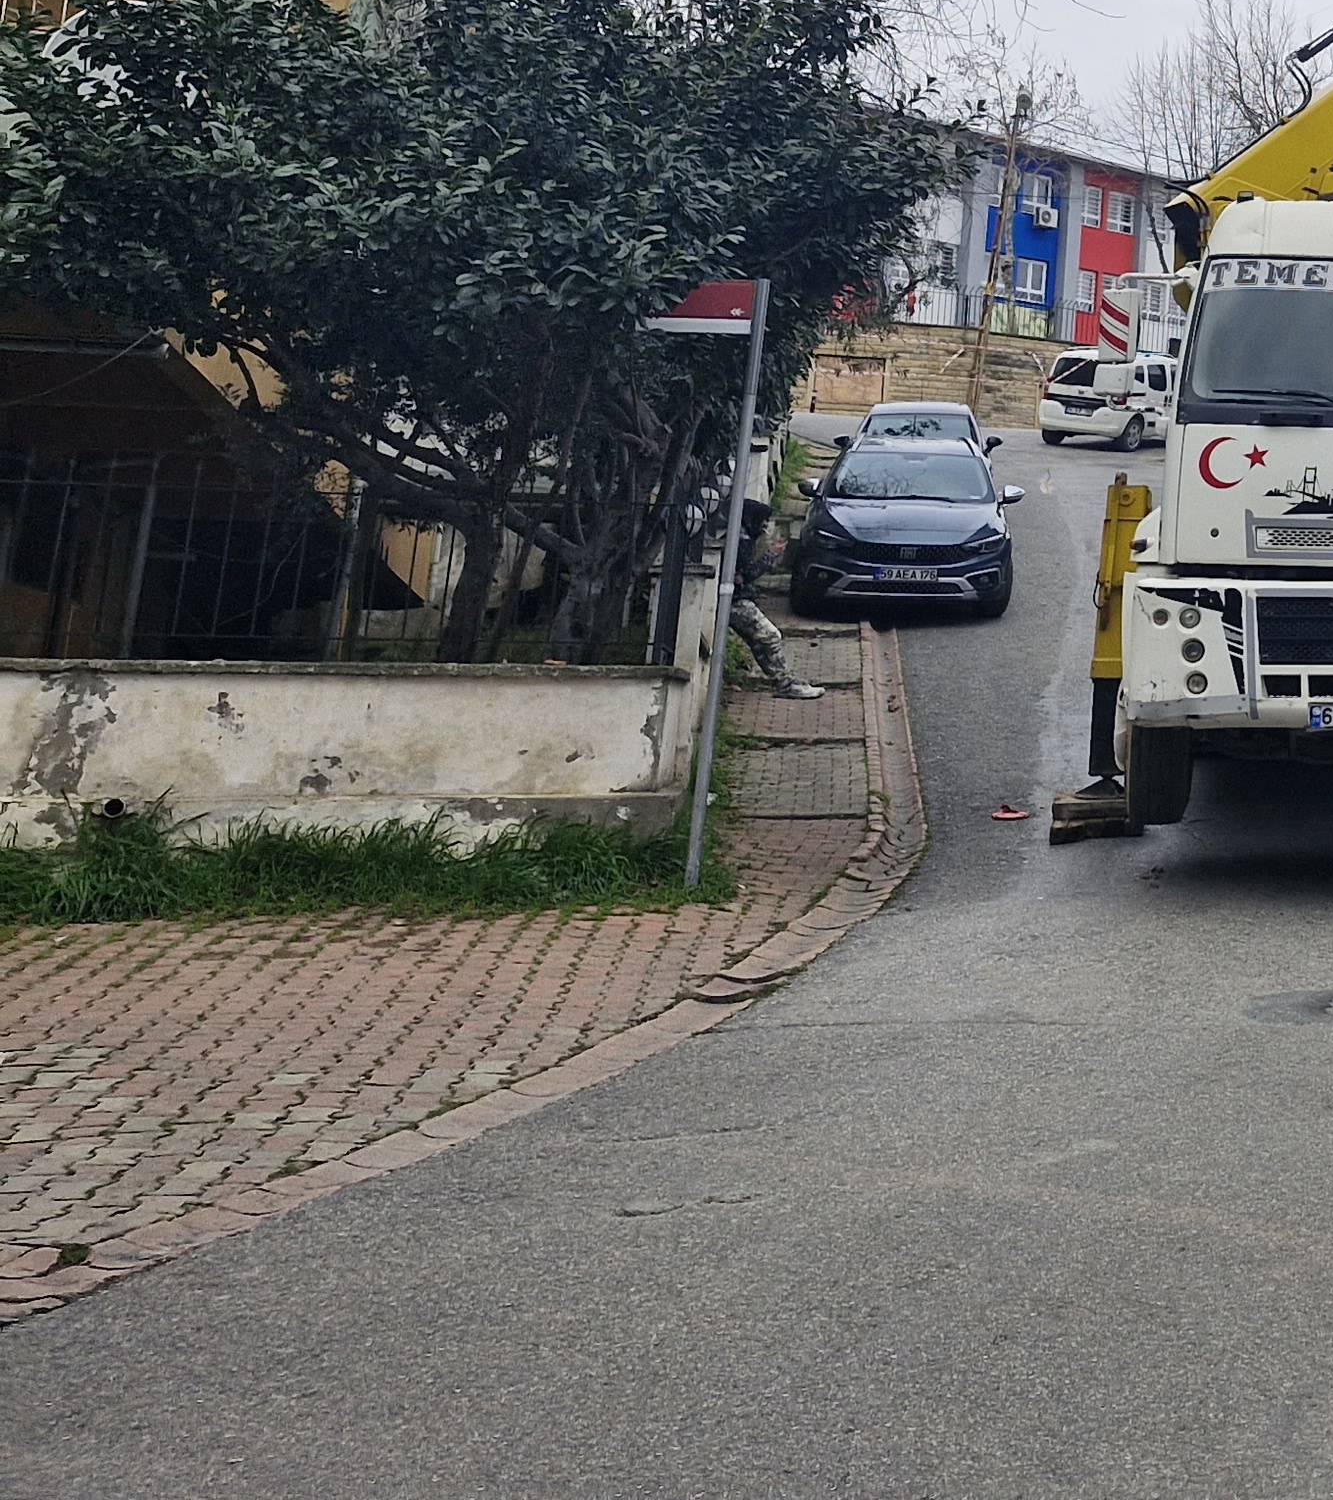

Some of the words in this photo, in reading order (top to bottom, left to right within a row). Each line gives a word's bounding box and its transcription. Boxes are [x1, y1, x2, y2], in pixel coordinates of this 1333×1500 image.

[881, 569, 893, 579] 59
[895, 569, 917, 580] AEA
[920, 570, 936, 580] 176
